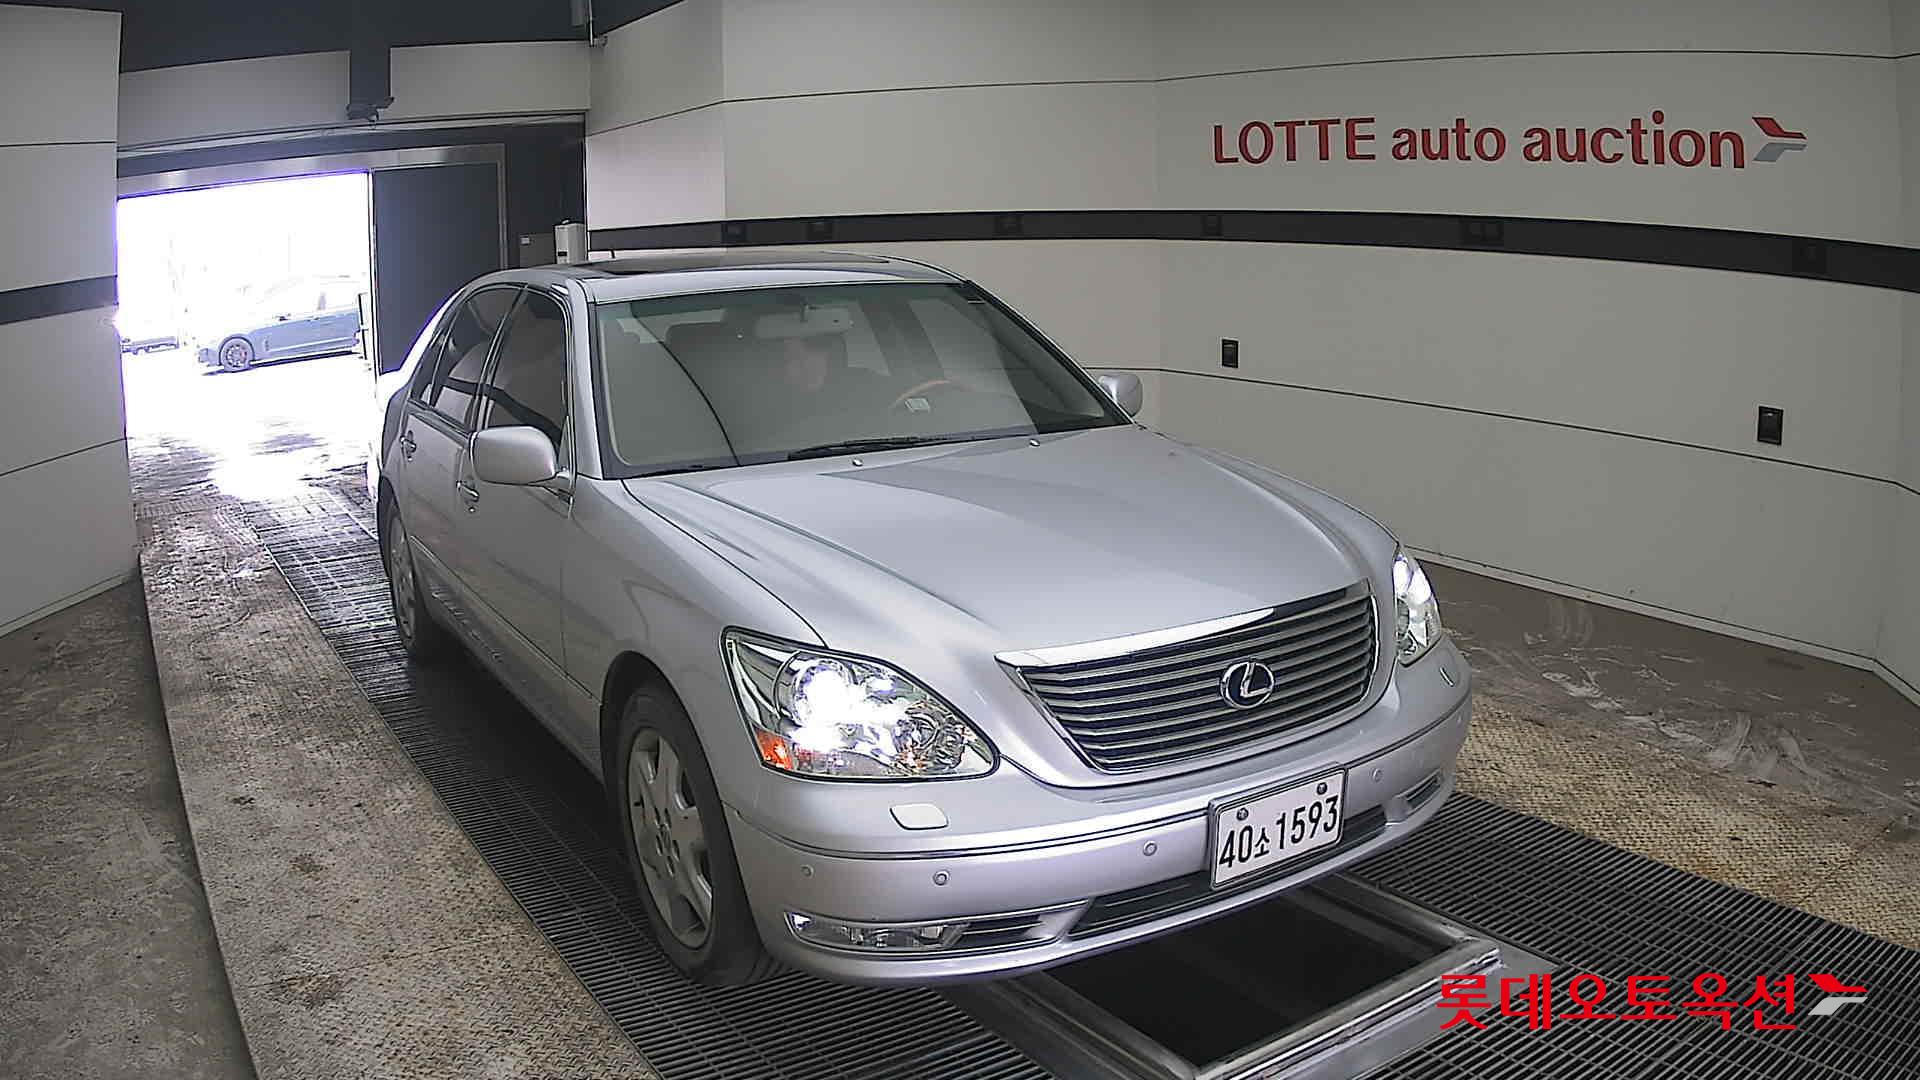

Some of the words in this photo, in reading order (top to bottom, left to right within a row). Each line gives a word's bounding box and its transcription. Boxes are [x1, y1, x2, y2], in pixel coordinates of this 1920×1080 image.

[1212, 117, 1376, 164] LOTTE
[1391, 118, 1507, 162] auto
[1522, 111, 1746, 169] auction
